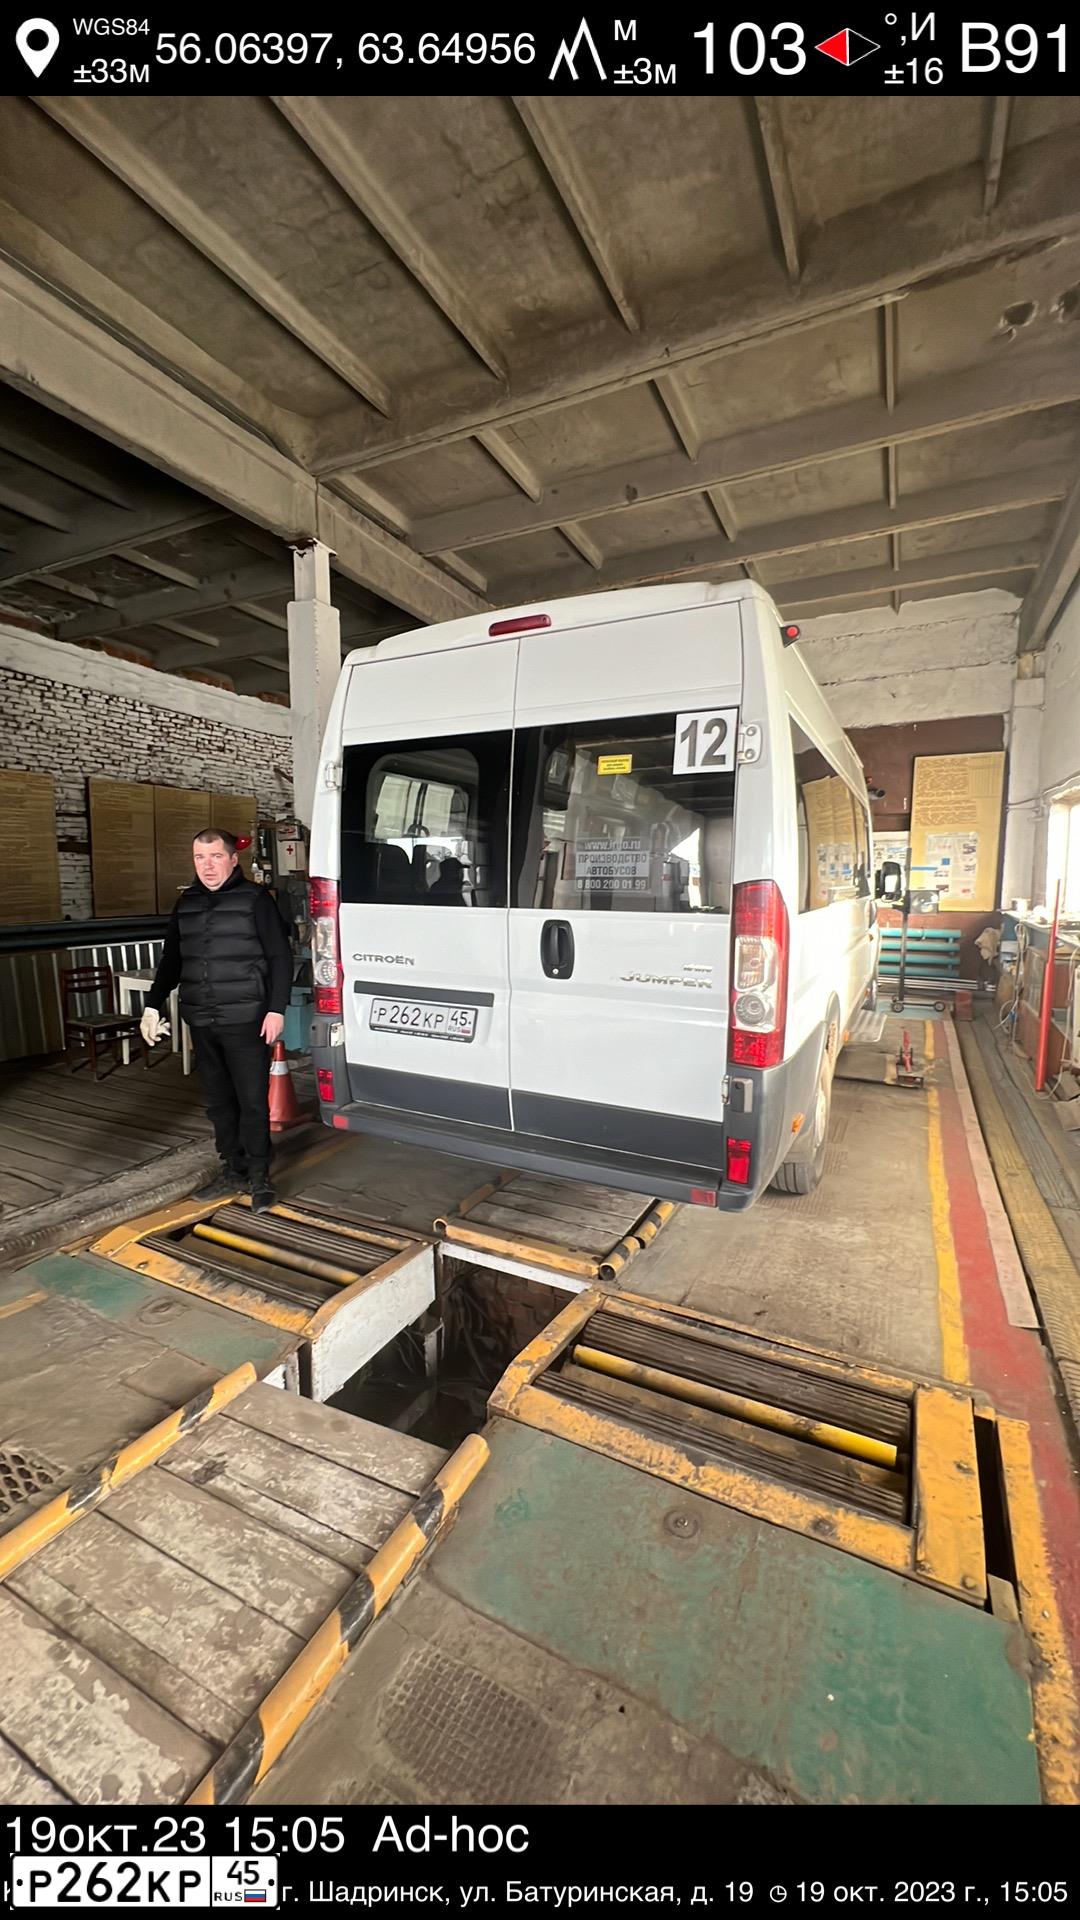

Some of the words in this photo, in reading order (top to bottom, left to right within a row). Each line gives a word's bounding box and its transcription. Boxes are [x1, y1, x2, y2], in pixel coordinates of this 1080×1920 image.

[680, 718, 728, 767] 12
[578, 853, 647, 864] ПРОИЗВОДСТВО
[585, 866, 637, 876] АВТОБУСОВ
[577, 879, 583, 889] 8
[585, 879, 601, 889] 800
[602, 879, 620, 889] 200
[621, 879, 632, 889] 01
[634, 879, 647, 890] 99
[619, 971, 713, 989] JUMPER
[450, 1010, 469, 1027] 45
